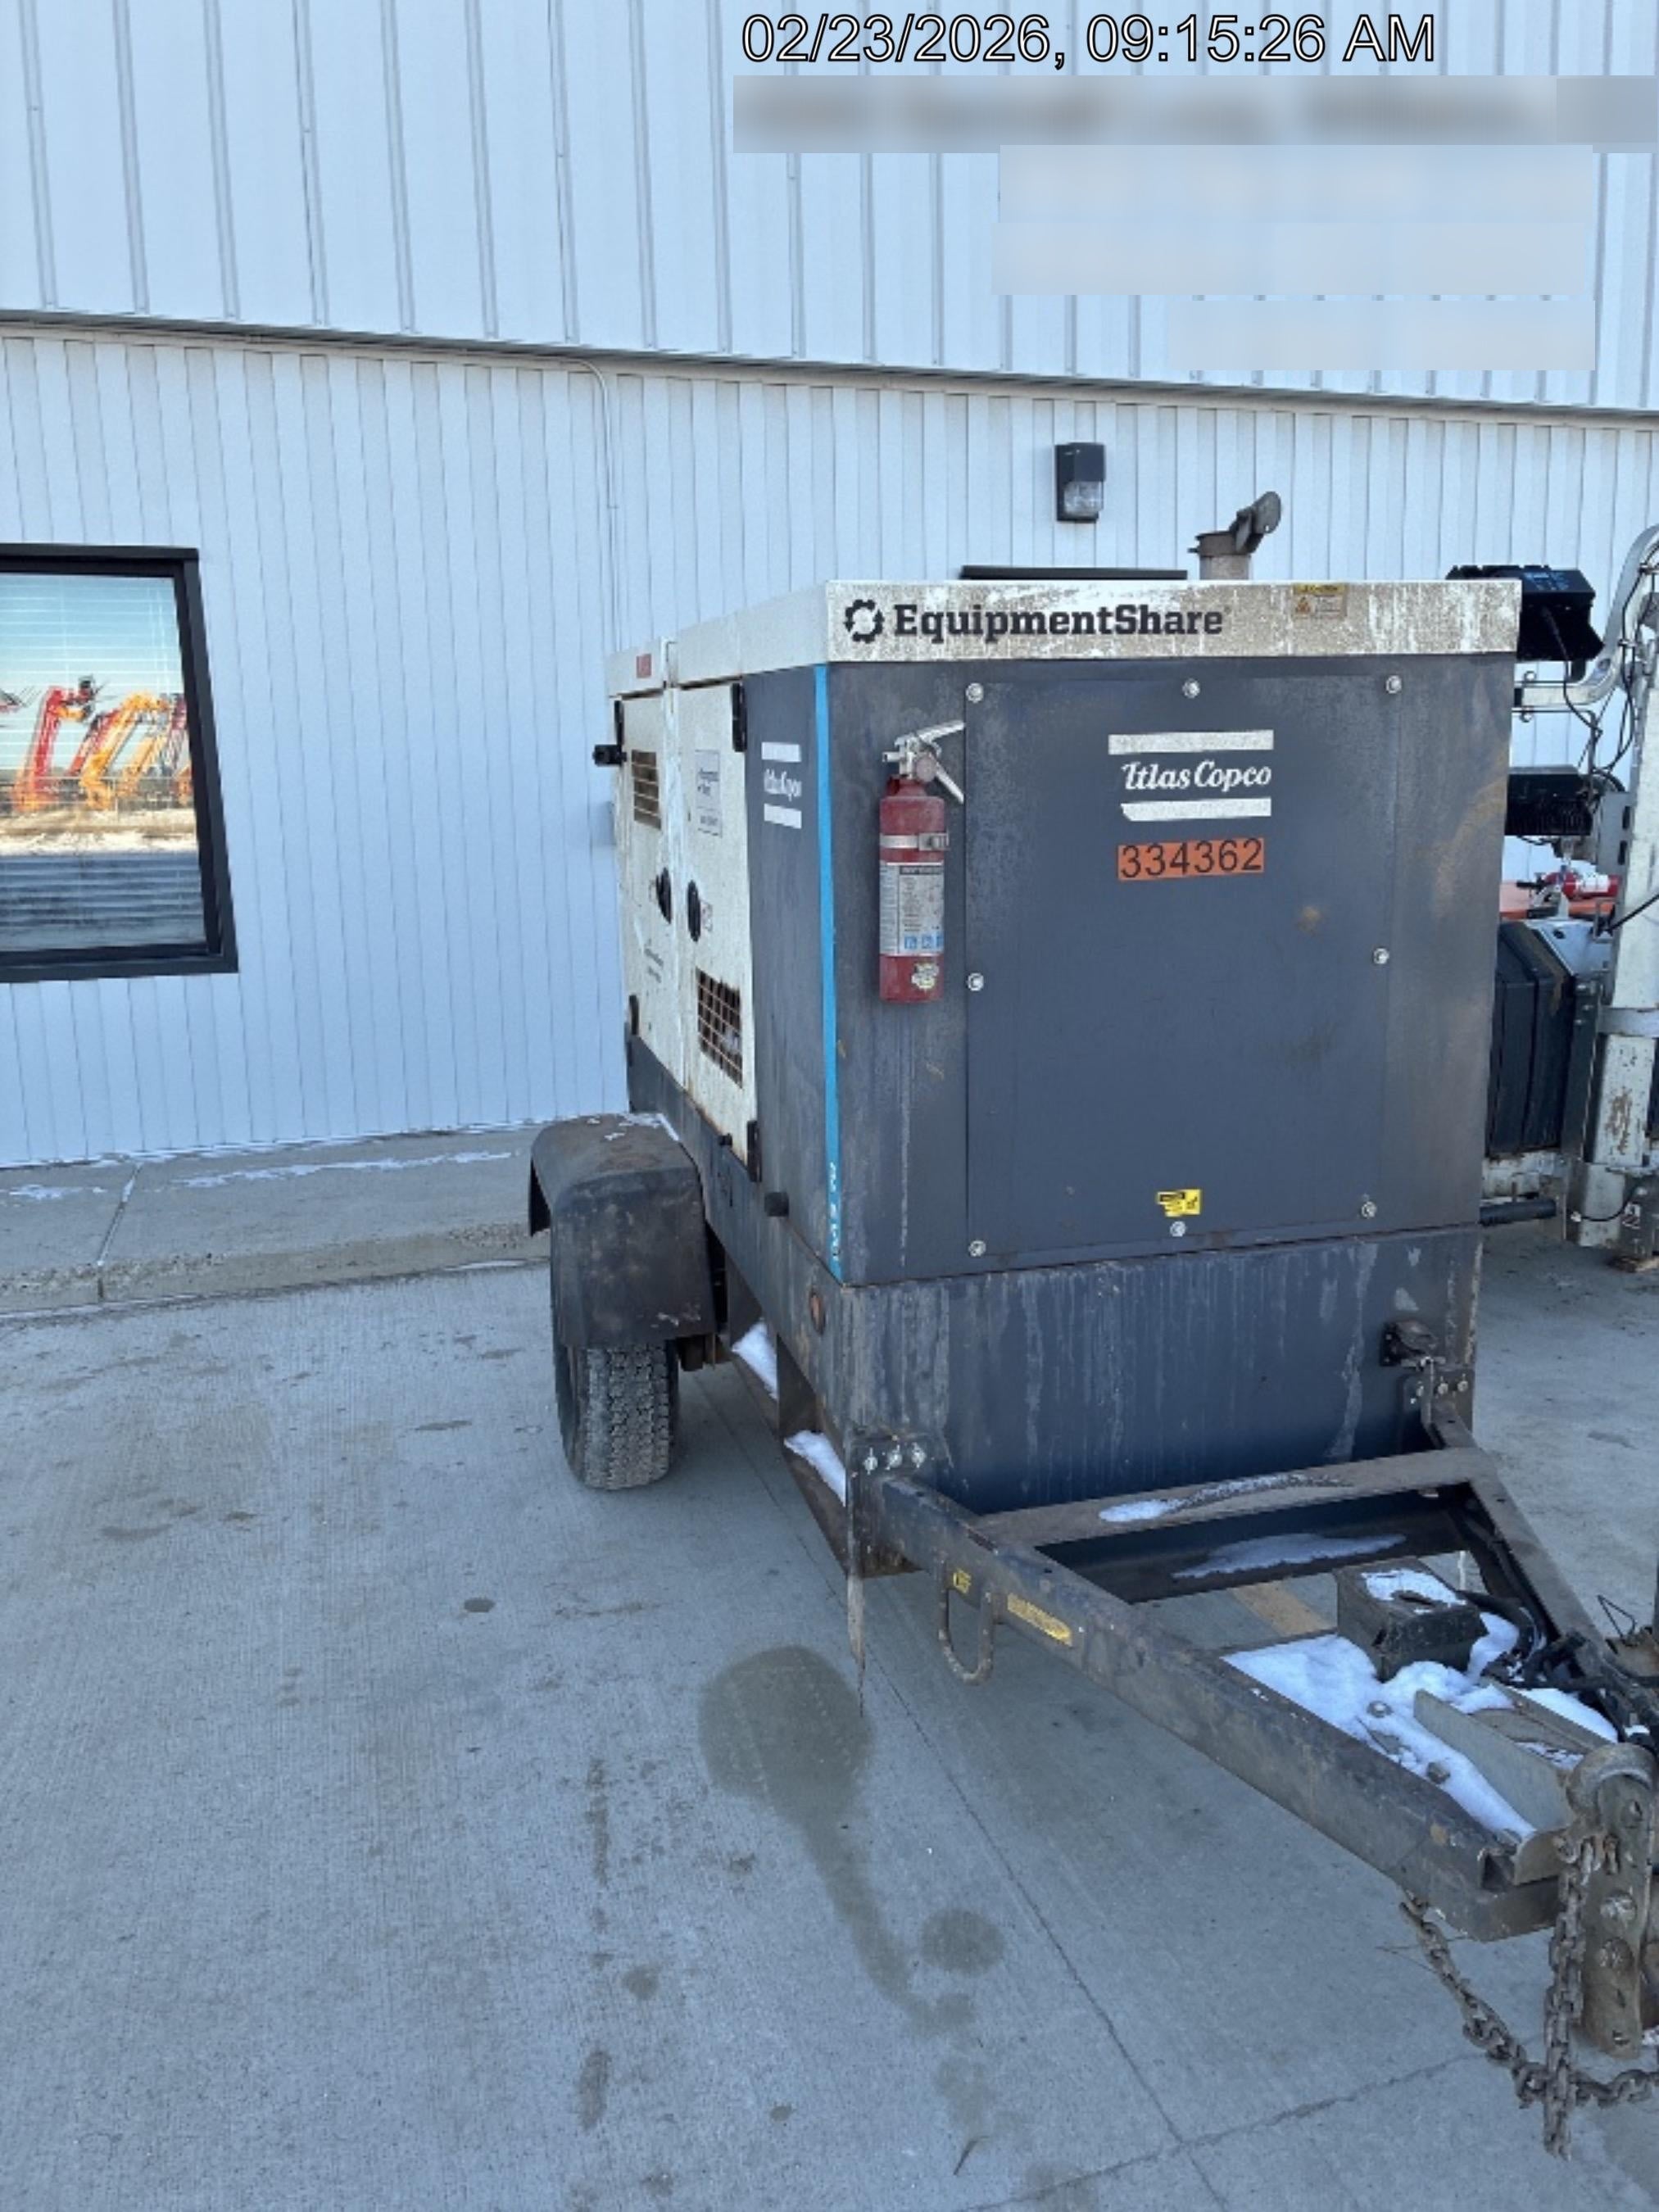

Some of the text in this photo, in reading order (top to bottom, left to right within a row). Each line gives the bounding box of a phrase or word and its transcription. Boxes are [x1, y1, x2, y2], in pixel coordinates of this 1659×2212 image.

[893, 604, 1223, 644] EquipmentShare
[1194, 758, 1271, 792] Copco
[1121, 837, 1262, 879] 334362
